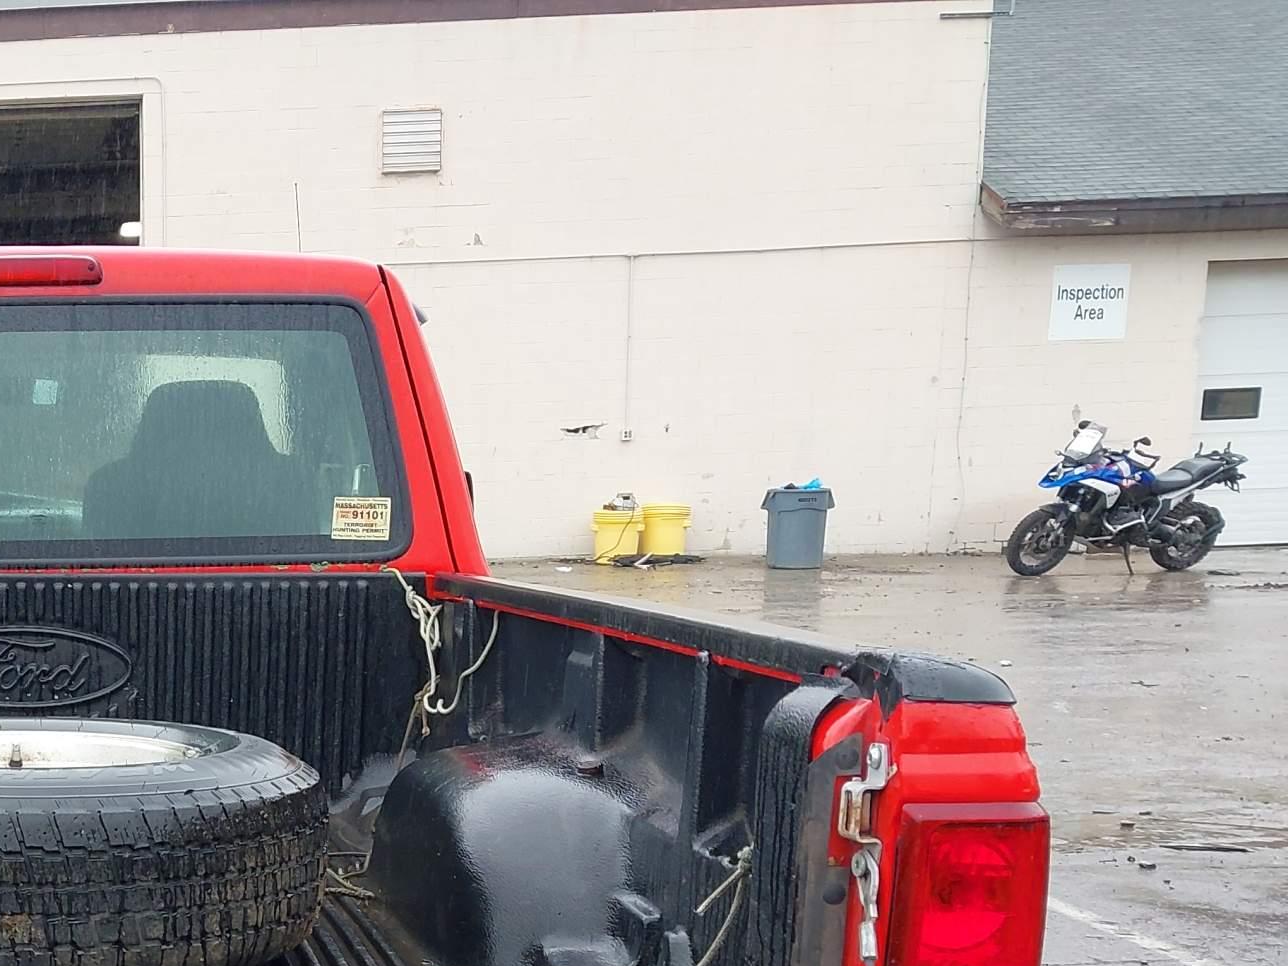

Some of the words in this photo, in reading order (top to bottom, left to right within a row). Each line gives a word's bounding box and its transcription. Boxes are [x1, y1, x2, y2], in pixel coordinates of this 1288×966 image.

[1057, 284, 1124, 303] Inspection
[1074, 305, 1104, 320] Area
[335, 502, 388, 510] MASSACHUSETTS
[352, 510, 384, 520] 91101
